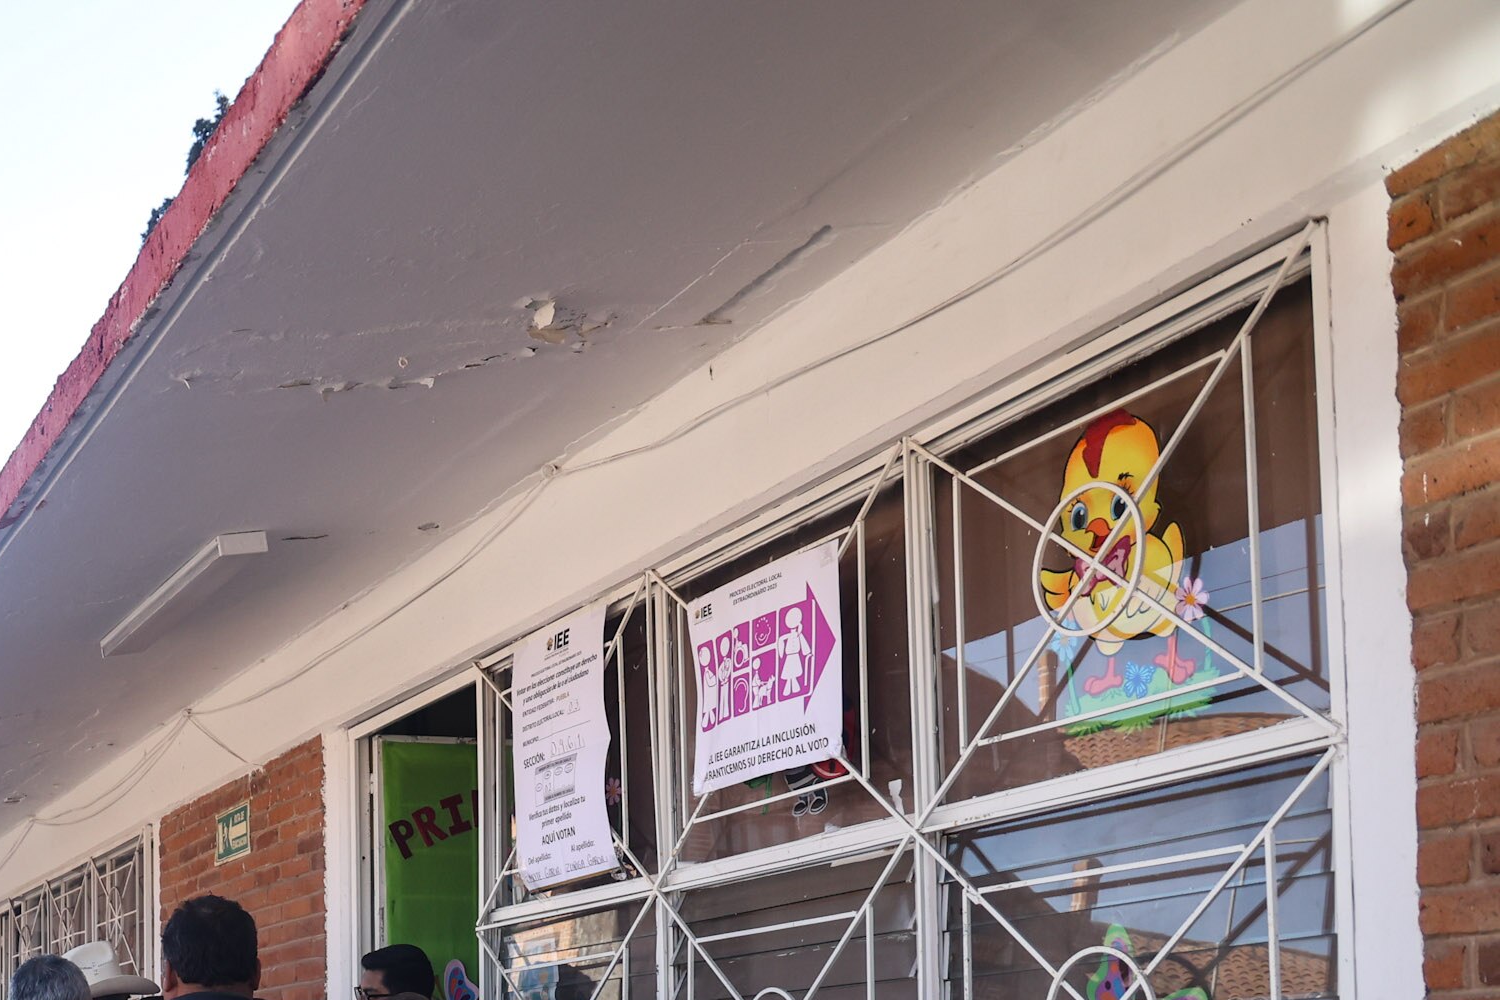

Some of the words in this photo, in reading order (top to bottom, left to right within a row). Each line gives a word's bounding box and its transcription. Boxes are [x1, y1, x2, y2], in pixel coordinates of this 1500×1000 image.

[729, 588, 746, 598] PROCESO
[747, 577, 768, 592] ELECTORAL
[768, 572, 783, 582] LOCAL
[733, 587, 767, 605] EXTRAORDINARIO
[701, 603, 713, 619] IEE
[554, 628, 570, 650] IEE
[581, 654, 598, 666] derecho
[714, 751, 724, 762] IEE
[724, 740, 761, 759] GARANTIZA
[761, 736, 771, 747] LA
[772, 723, 816, 745] INCLUSIÓN
[523, 751, 546, 769] SECCIÓN:
[747, 755, 756, 768] SU
[757, 746, 794, 765] DERECHO
[795, 743, 806, 756] AL
[808, 737, 829, 752] VOTO
[541, 830, 556, 845] AQUÍ
[556, 826, 576, 841] VOTAN
